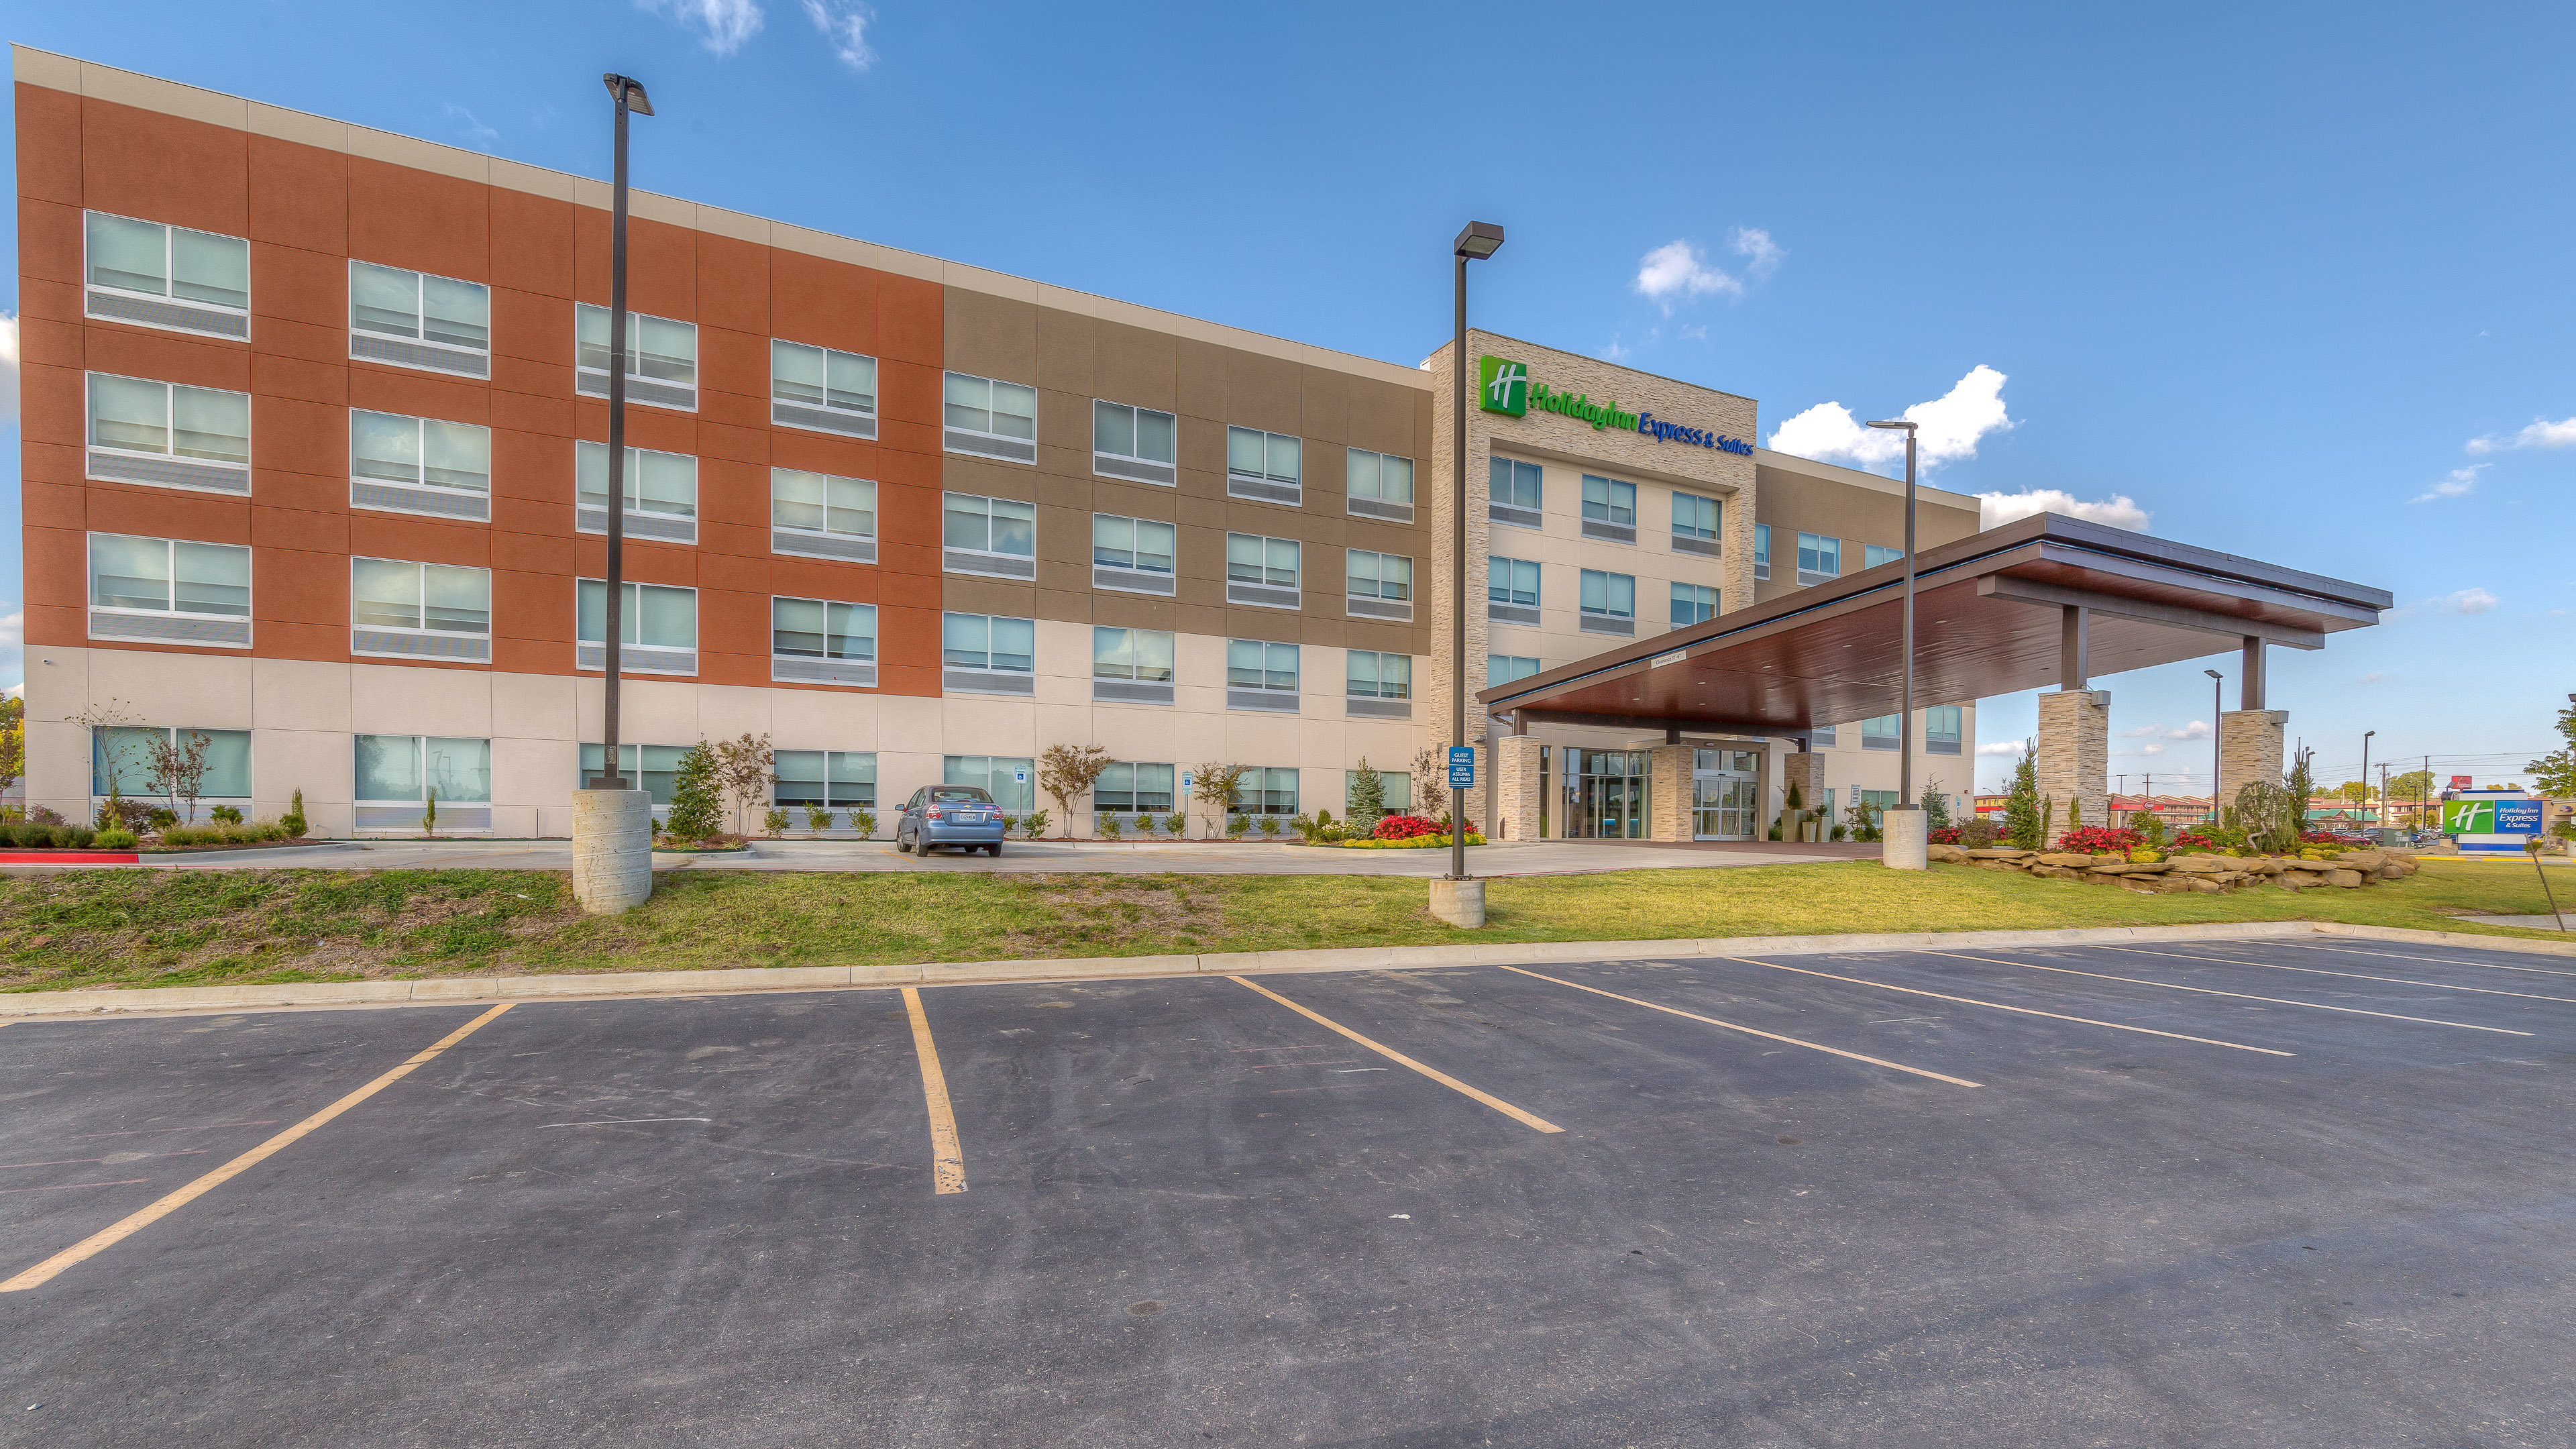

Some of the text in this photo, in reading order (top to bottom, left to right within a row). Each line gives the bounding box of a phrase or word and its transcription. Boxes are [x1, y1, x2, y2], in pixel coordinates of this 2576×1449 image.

[1529, 382, 1754, 455] Holiday Inn Express & Suites
[2499, 814, 2539, 823] Express
